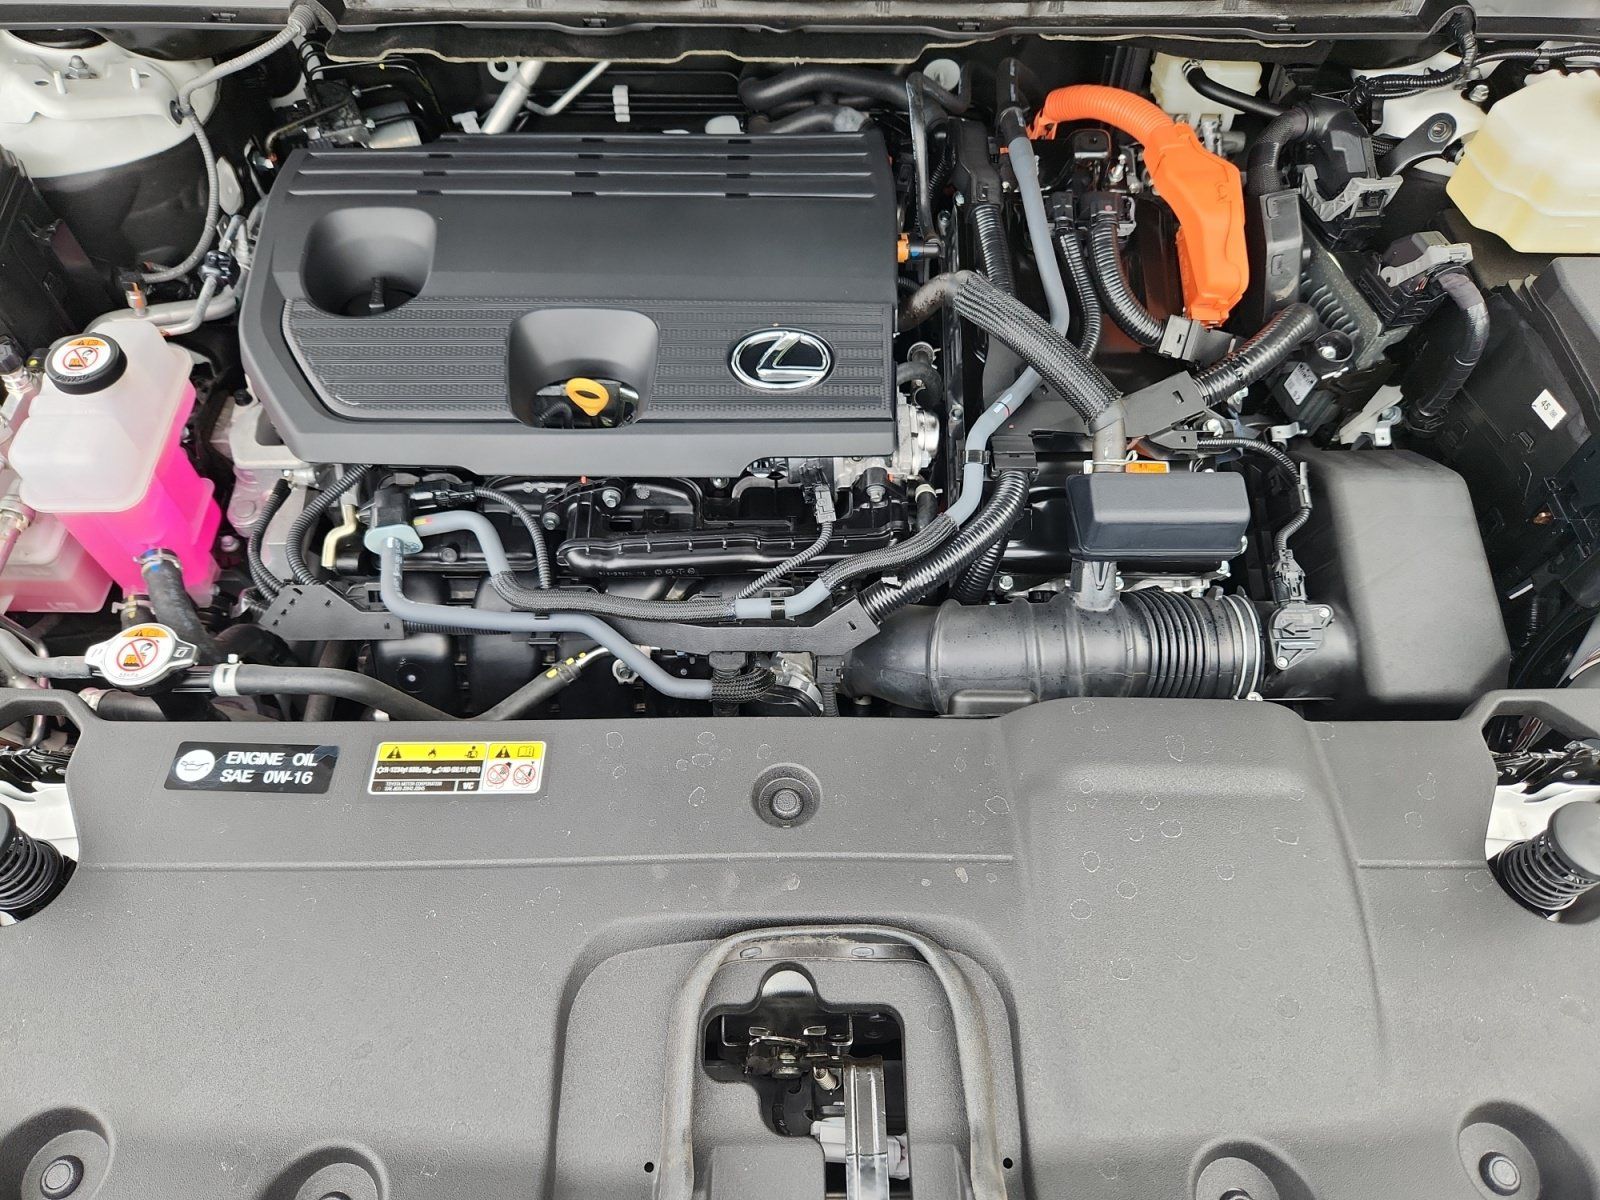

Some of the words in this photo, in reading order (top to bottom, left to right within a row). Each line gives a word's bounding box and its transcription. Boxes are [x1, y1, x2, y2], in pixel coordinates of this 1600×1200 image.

[1541, 400, 1551, 411] 45
[225, 751, 285, 766] ENGINE
[292, 752, 318, 766] OIL
[219, 768, 255, 783] SAE
[262, 770, 314, 785] 0W-16
[462, 781, 475, 790] VC
